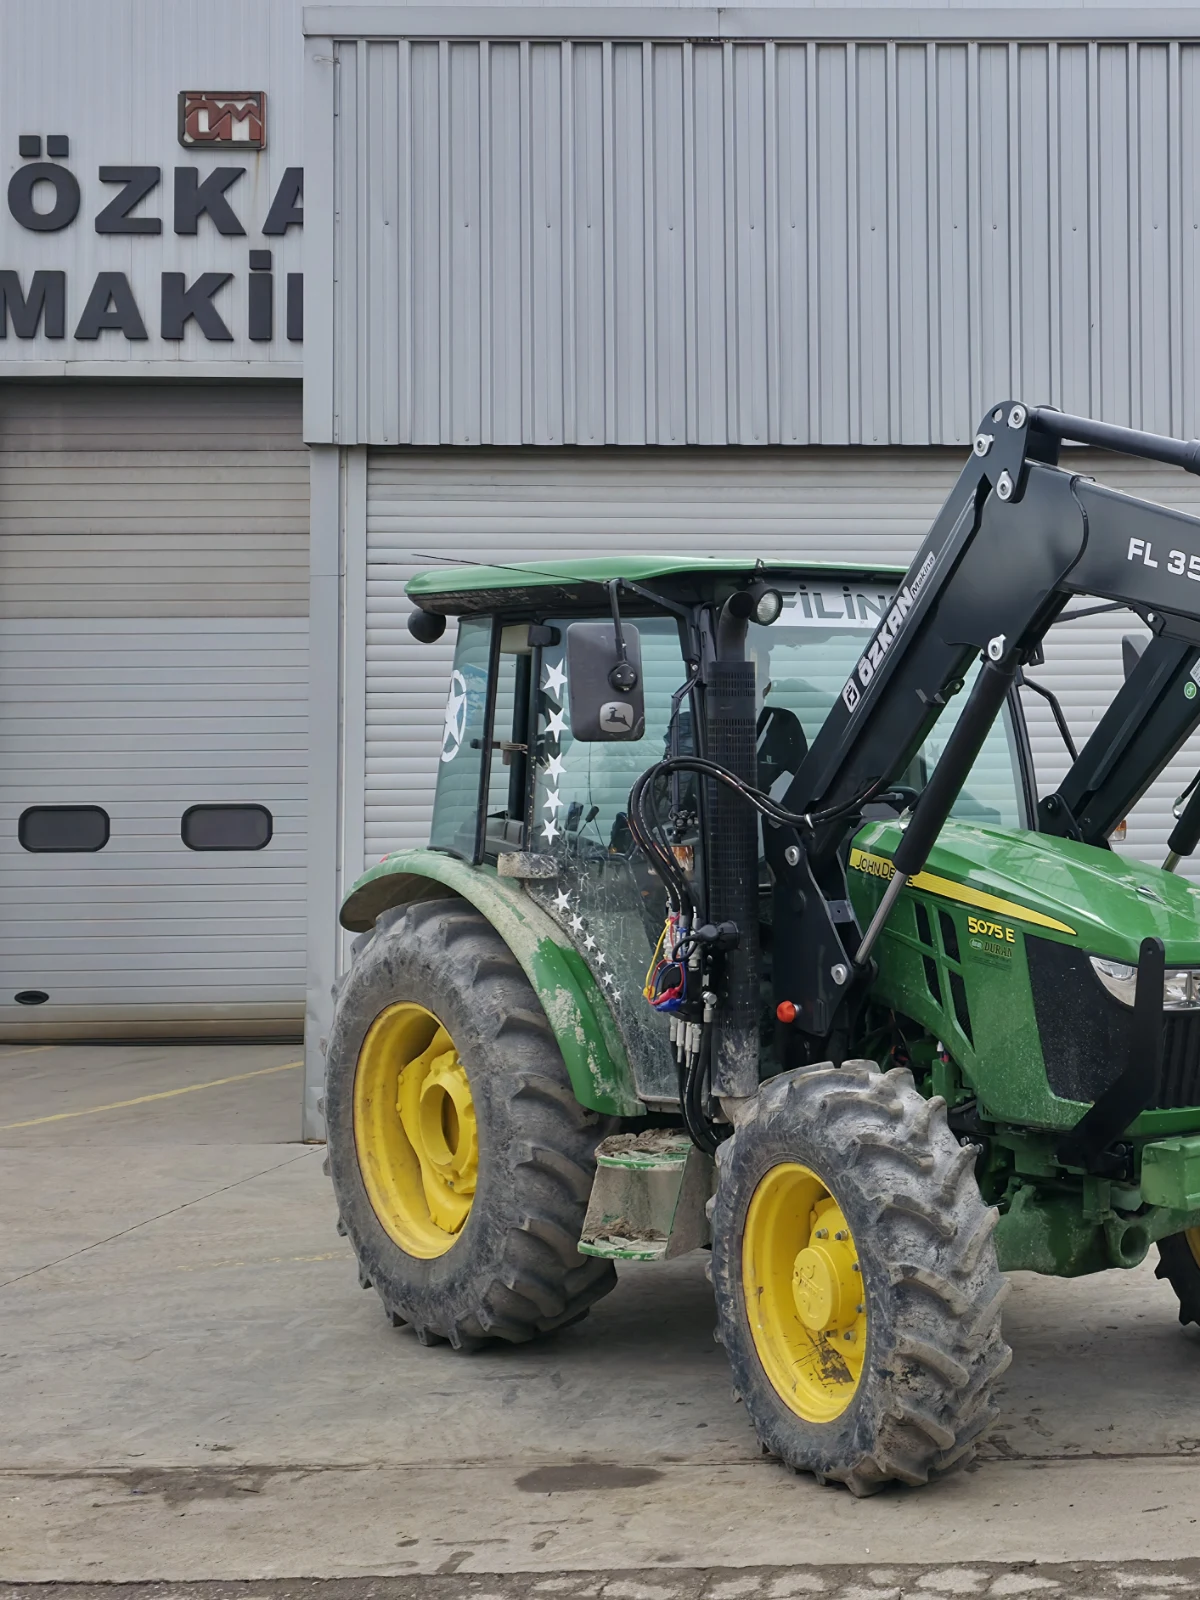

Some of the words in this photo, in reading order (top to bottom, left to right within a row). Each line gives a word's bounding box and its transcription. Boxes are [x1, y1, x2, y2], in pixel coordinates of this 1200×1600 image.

[0, 249, 304, 341] MAKİ
[1127, 537, 1158, 568] FL
[858, 585, 914, 687] ÖZKAN
[911, 556, 934, 595] Makina
[856, 854, 881, 877] JOHN
[968, 916, 1003, 939] 5075
[1005, 927, 1016, 943] E
